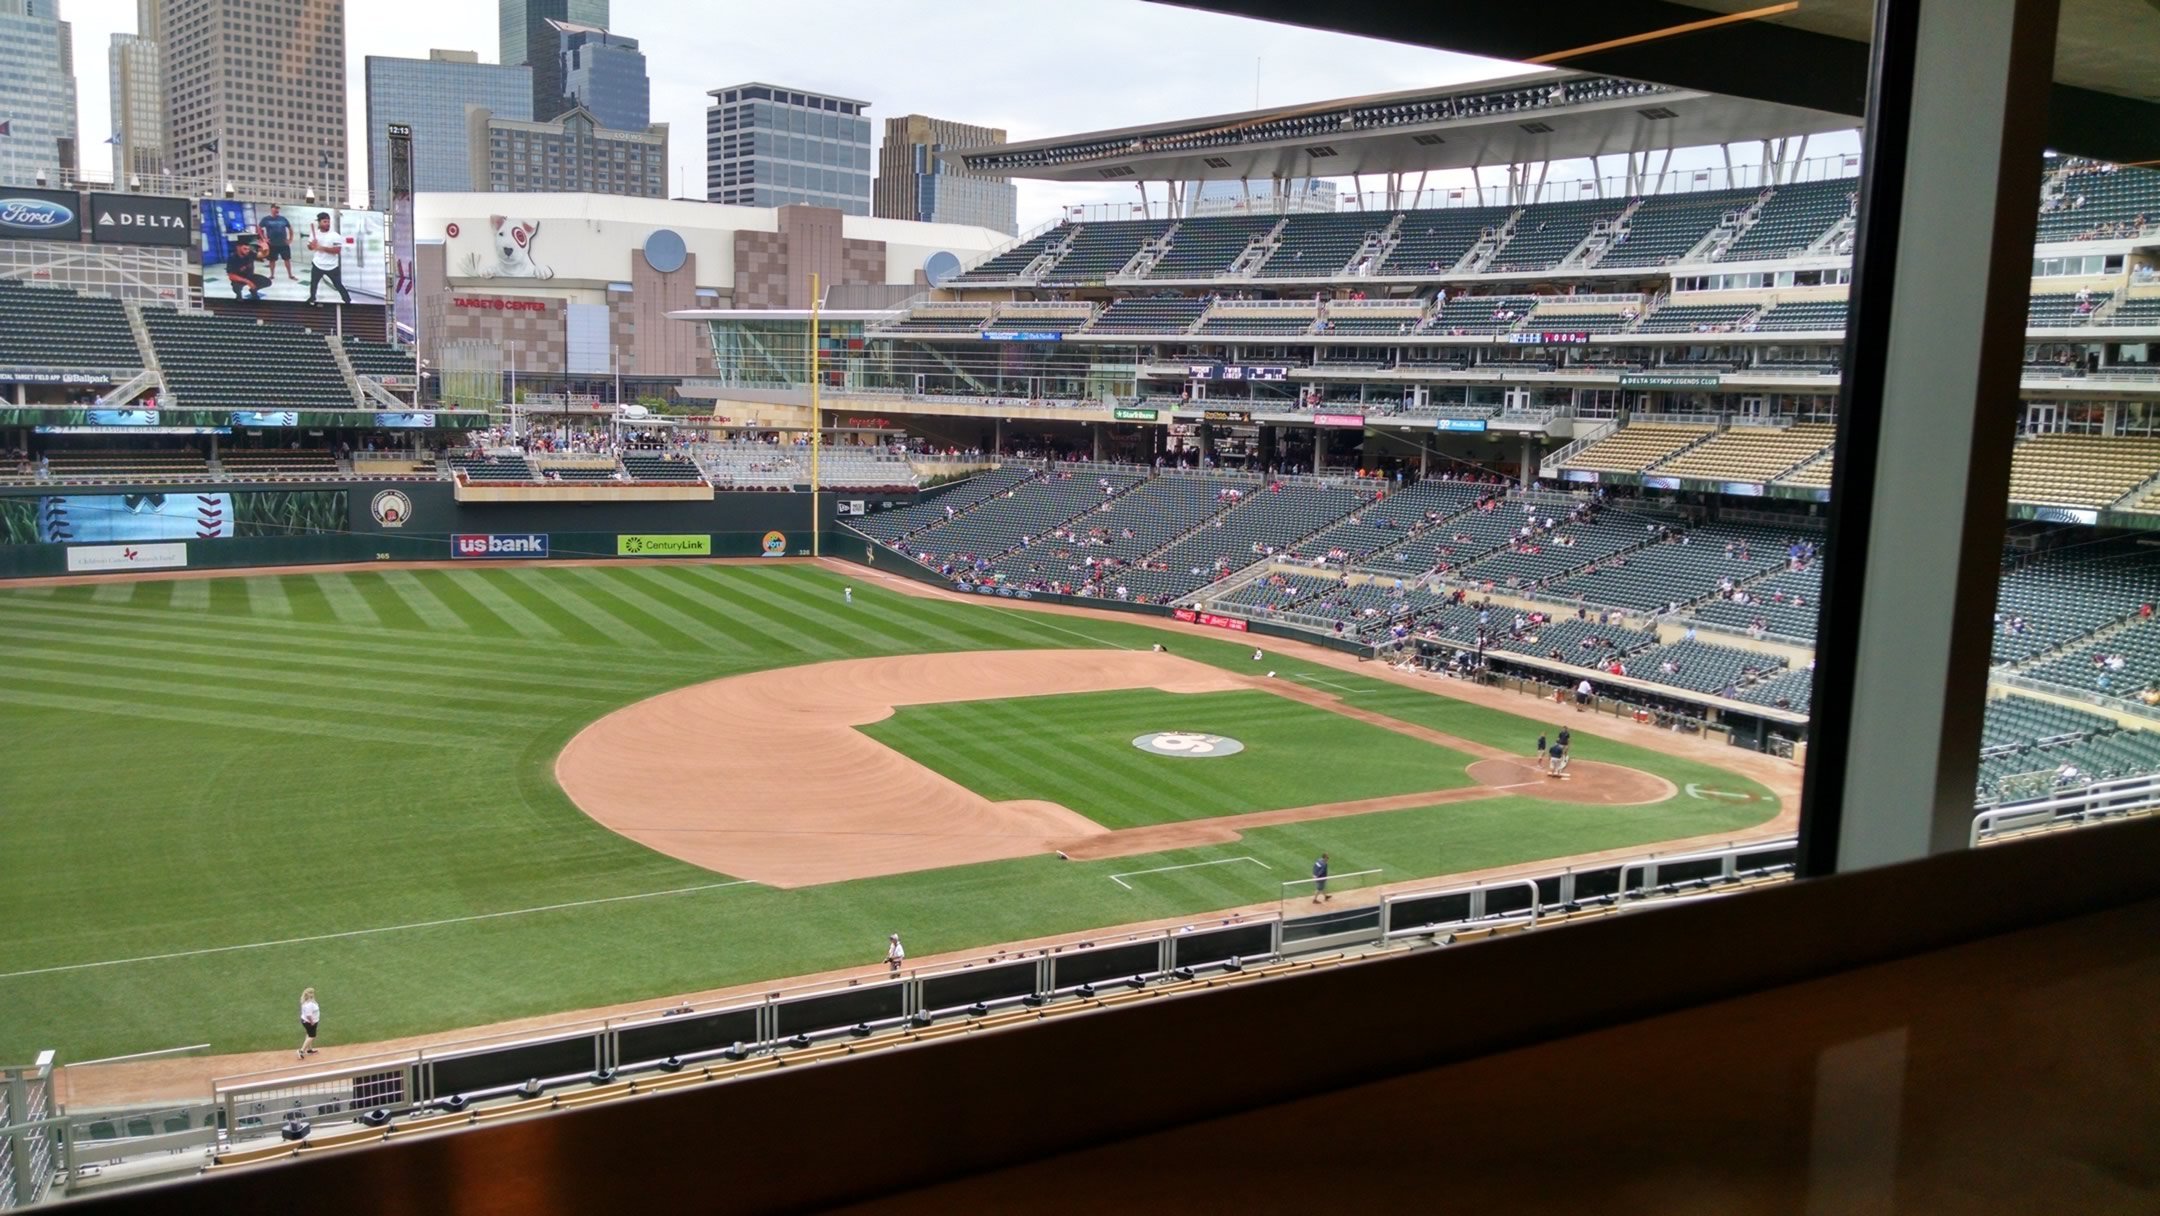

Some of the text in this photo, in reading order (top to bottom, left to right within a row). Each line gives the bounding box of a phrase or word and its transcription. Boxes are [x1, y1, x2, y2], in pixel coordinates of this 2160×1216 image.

[389, 126, 409, 134] 12:13
[2, 203, 55, 225] Ford
[120, 213, 185, 228] DELTA
[453, 298, 545, 312] TARGET CENTER
[646, 540, 703, 551] CenturyLink
[375, 552, 391, 560] 365
